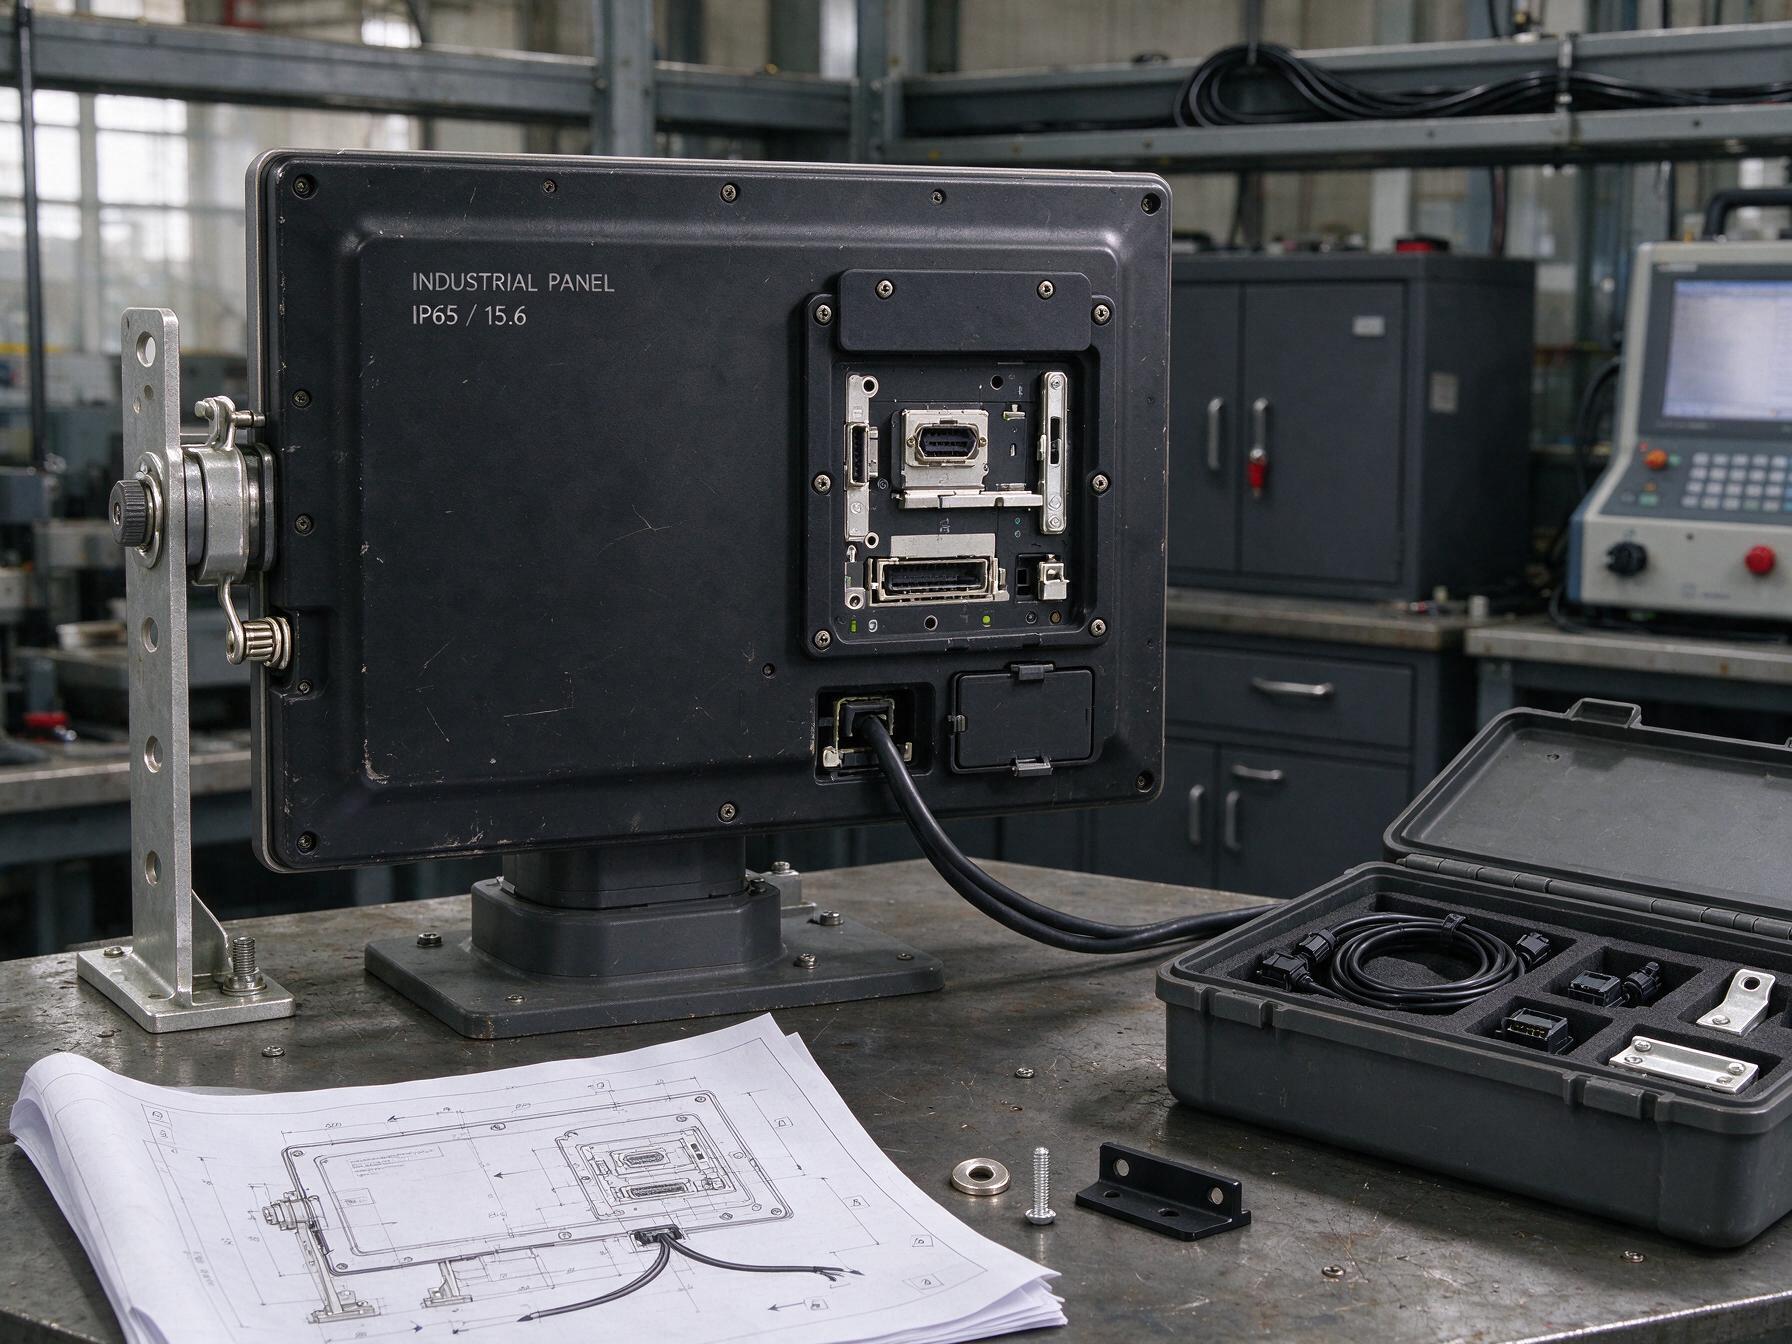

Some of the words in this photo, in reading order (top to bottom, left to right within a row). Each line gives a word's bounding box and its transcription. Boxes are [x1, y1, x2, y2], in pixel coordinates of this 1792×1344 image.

[412, 272, 538, 292] INDUSTRIAL
[548, 273, 615, 293] PANEL
[412, 305, 459, 326] IP65
[465, 303, 478, 327] /
[484, 305, 527, 326] 15.6
